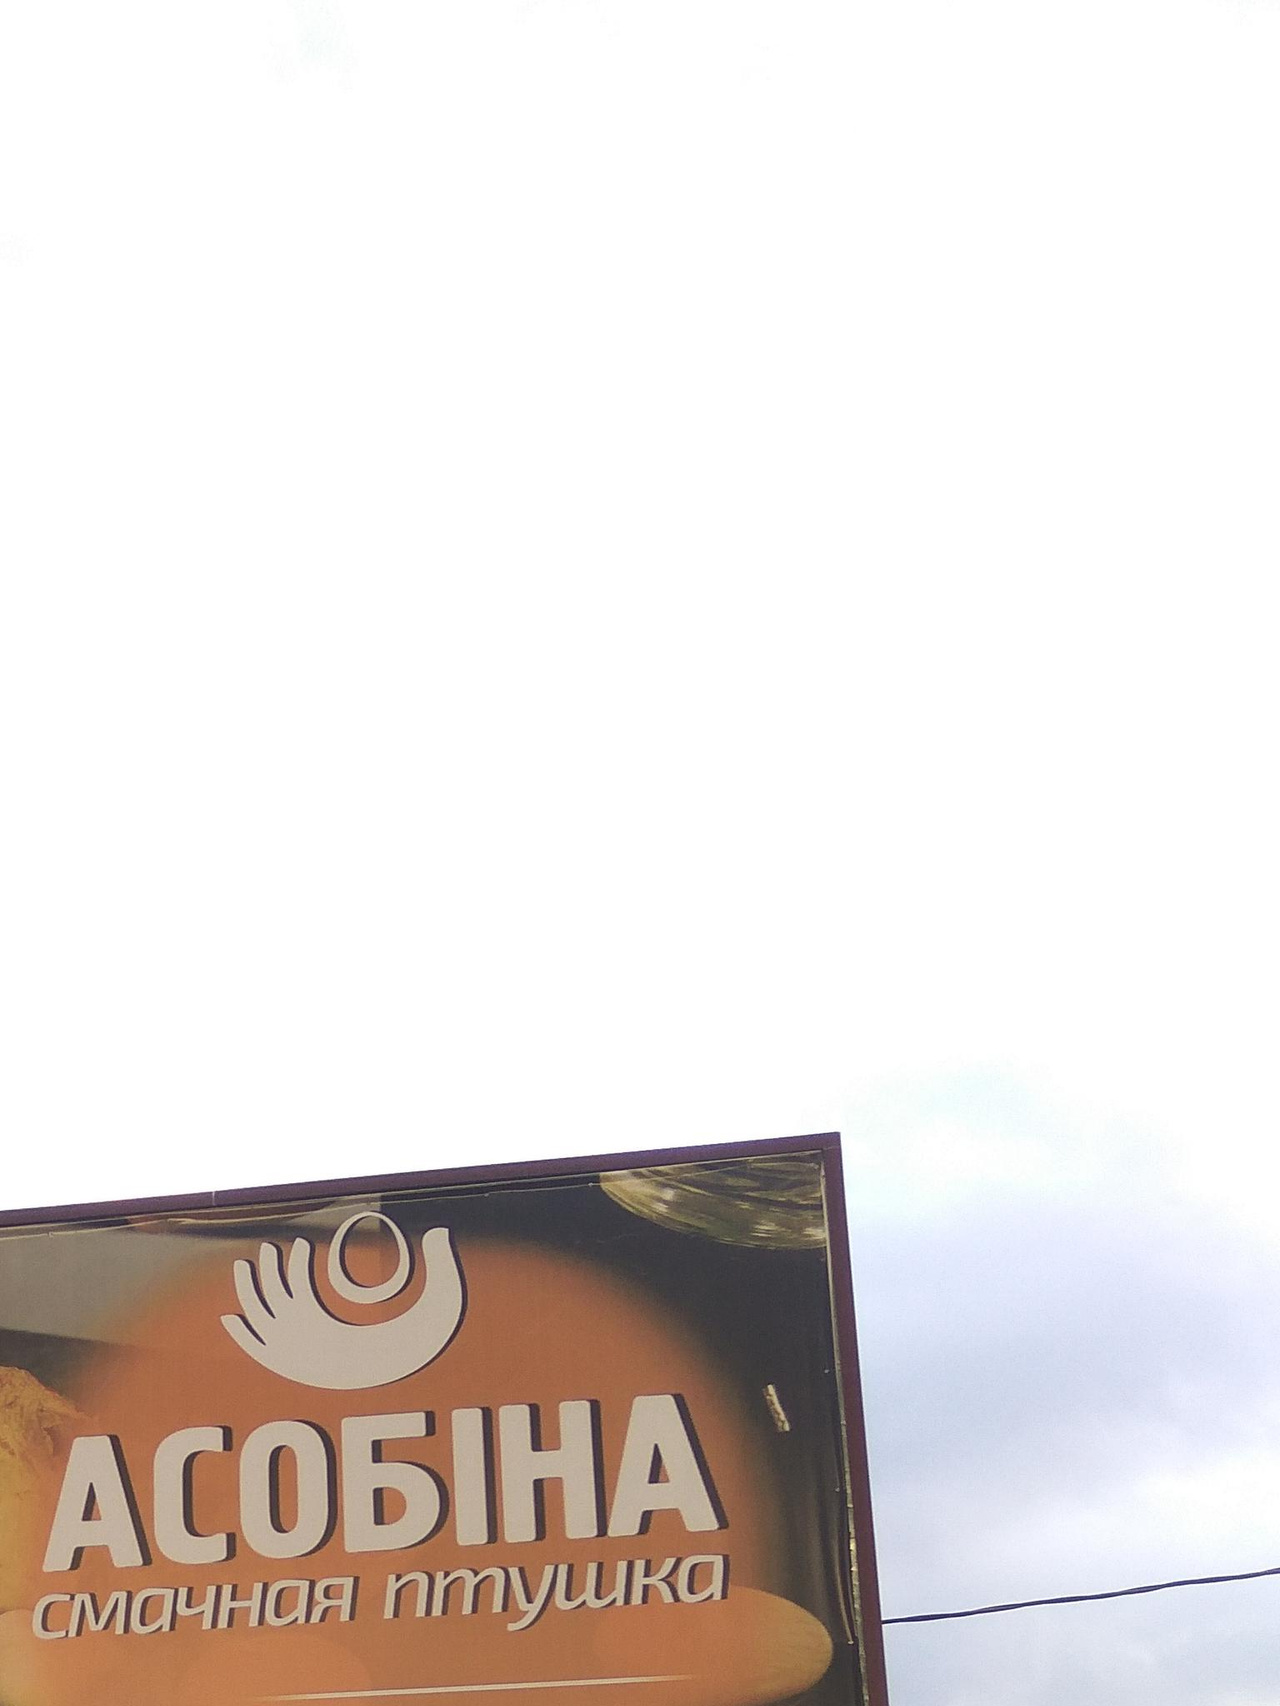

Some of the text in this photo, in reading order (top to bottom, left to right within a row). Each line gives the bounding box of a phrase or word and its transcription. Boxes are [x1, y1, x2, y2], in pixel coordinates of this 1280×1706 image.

[42, 1393, 726, 1573] АСОБІНА
[32, 1552, 728, 1640] смачная птушка
